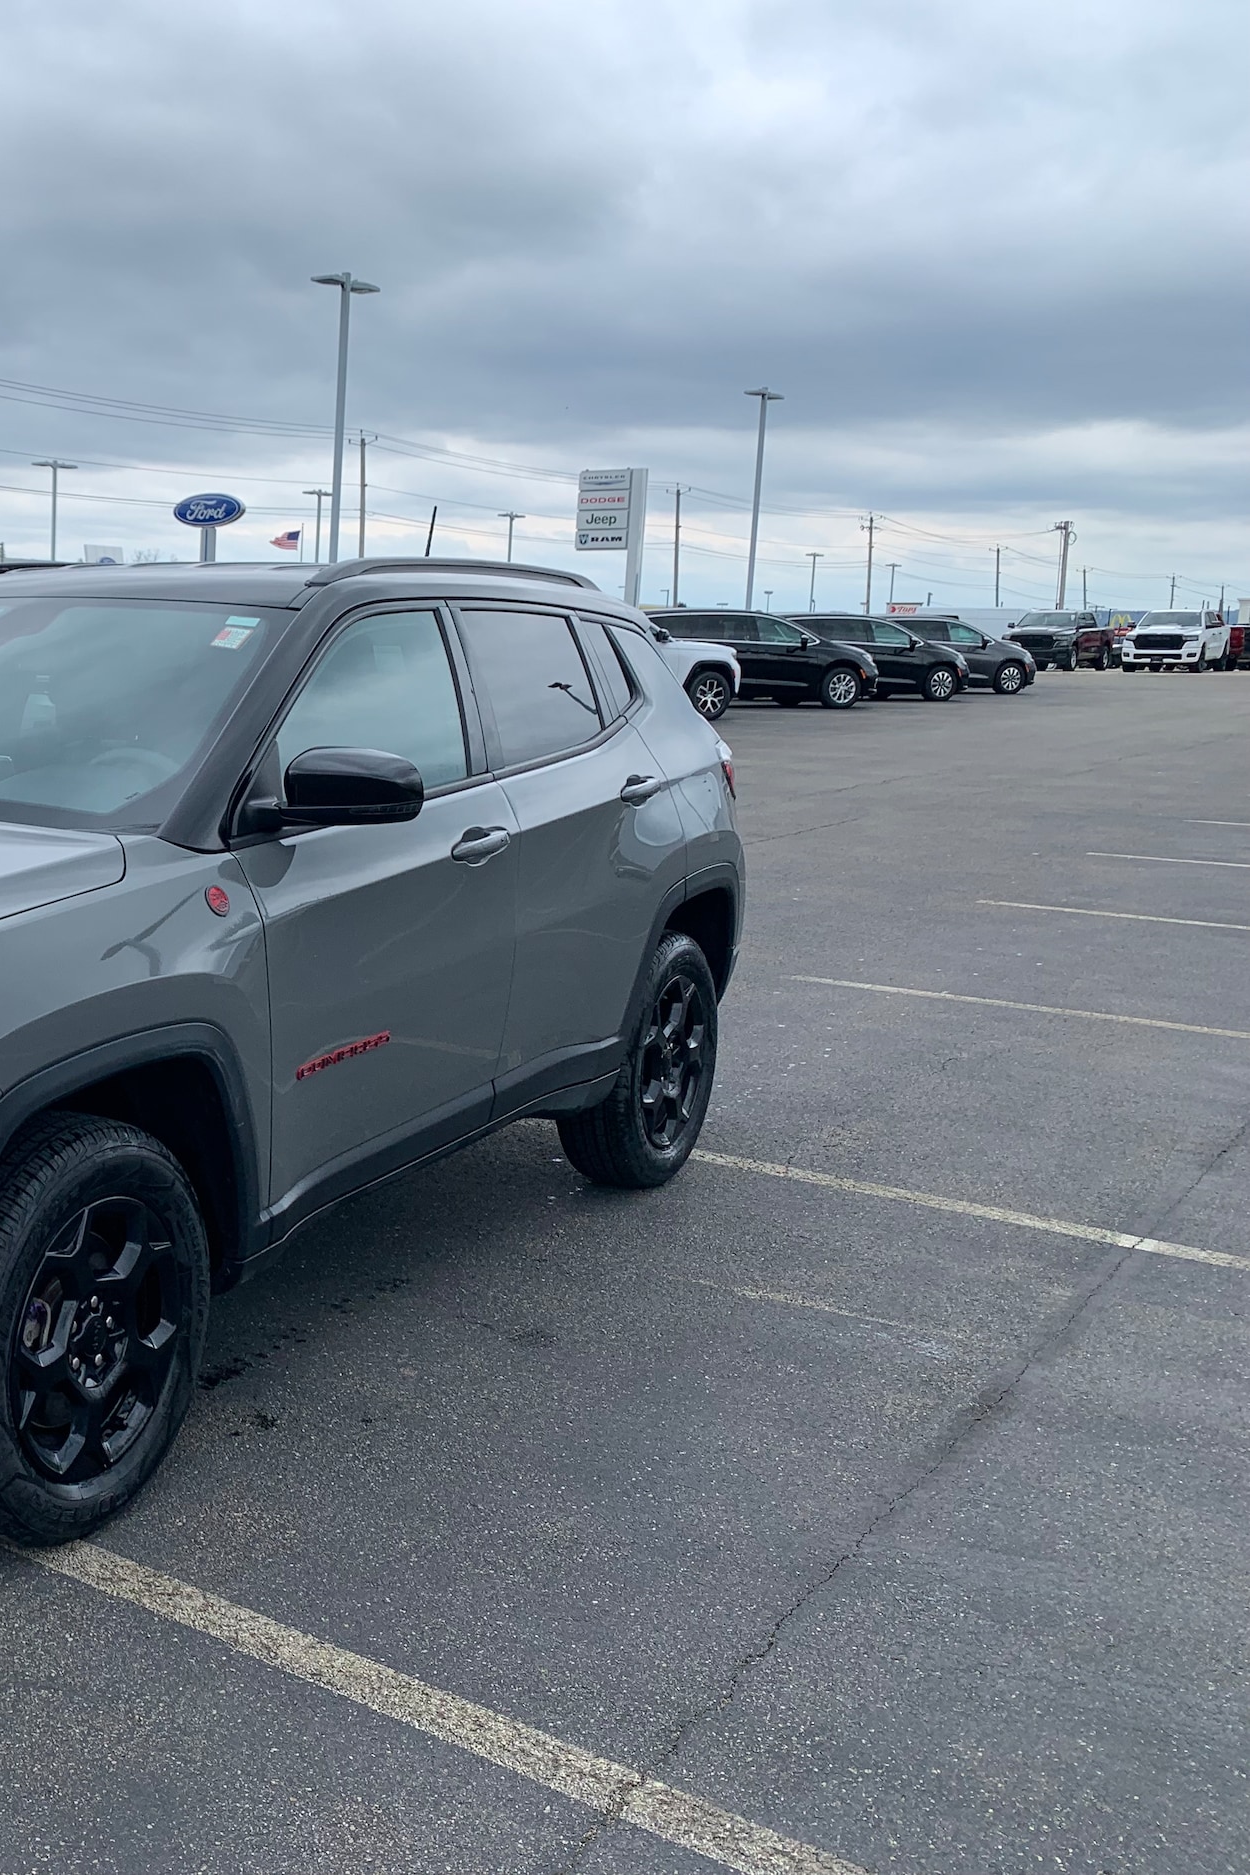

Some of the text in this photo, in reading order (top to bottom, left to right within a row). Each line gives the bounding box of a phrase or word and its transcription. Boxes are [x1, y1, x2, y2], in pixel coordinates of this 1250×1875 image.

[580, 496, 626, 504] DODGE
[186, 499, 227, 521] Ford
[586, 513, 617, 526] Jeep
[296, 1029, 391, 1081] COMPASS
